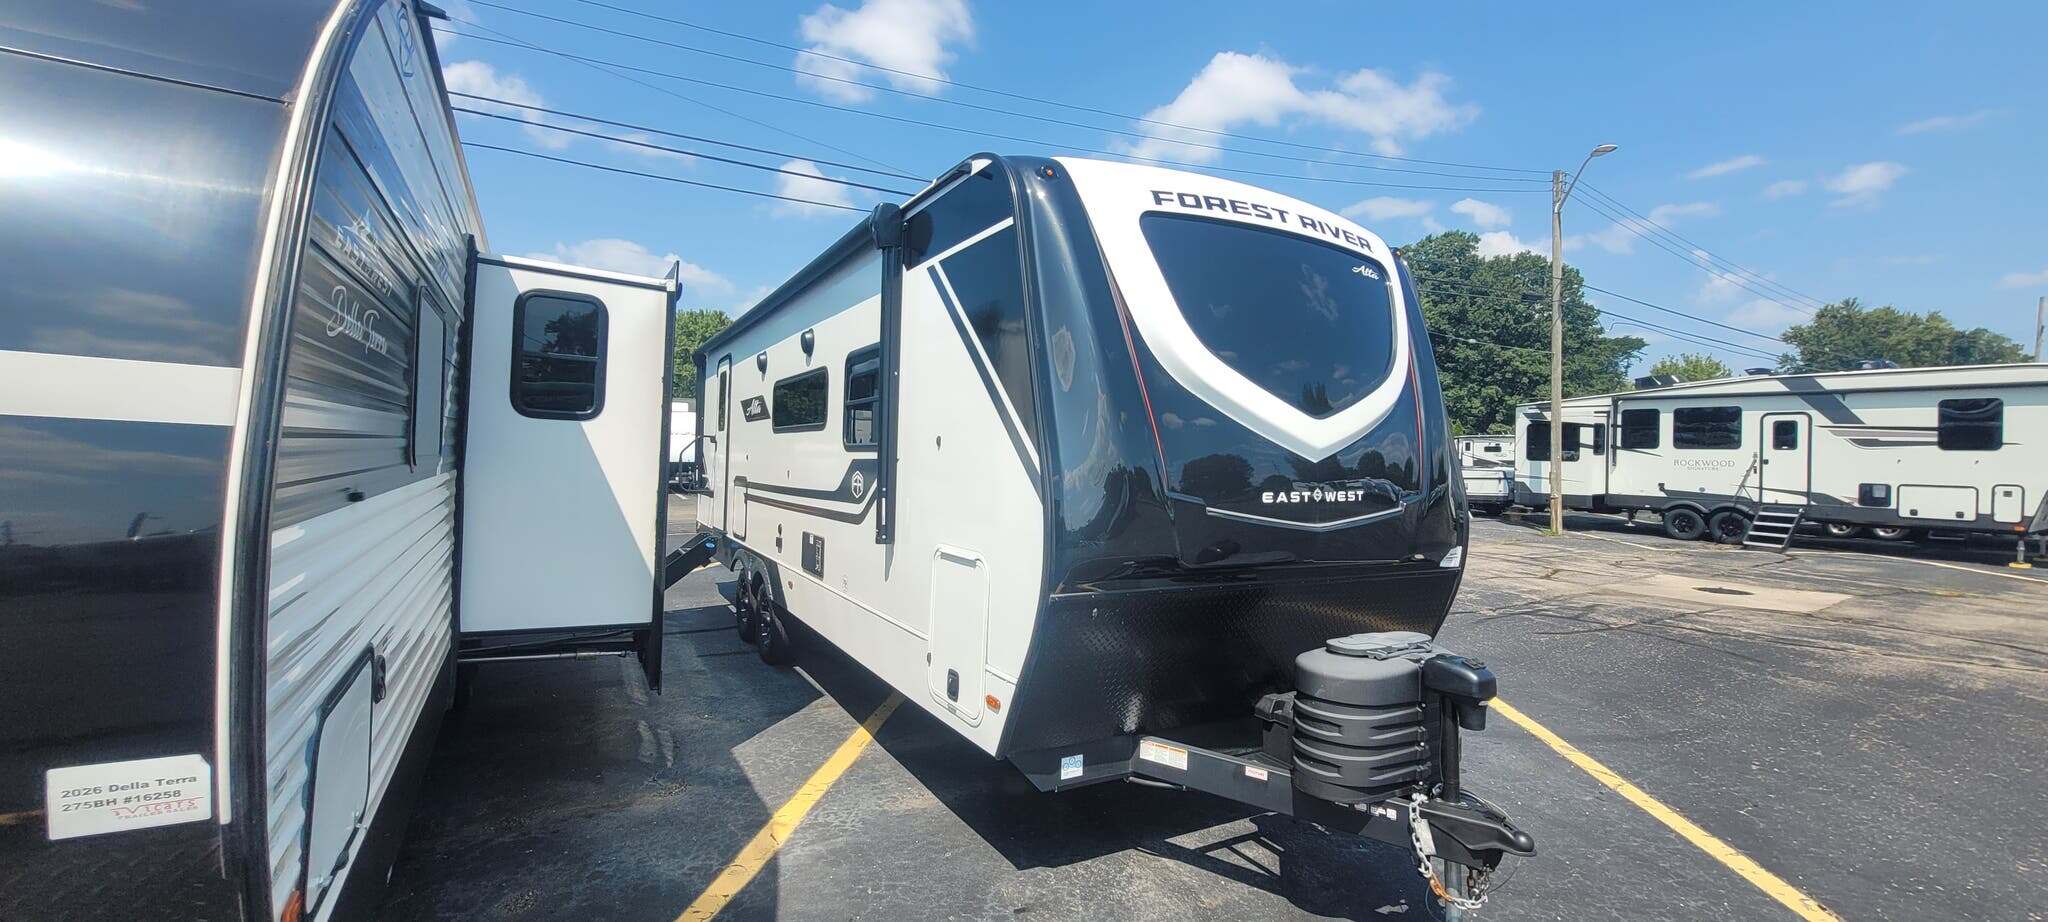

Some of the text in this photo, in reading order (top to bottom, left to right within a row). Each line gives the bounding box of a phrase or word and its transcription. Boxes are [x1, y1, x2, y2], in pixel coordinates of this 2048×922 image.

[1150, 190, 1374, 253] FOREST RIVER
[1352, 265, 1379, 280] Alta
[326, 285, 363, 340] Della
[1673, 459, 1735, 467] ROCKWOOD
[1262, 490, 1364, 503] EAST WEST
[60, 776, 197, 798] 2026 Della Terra
[62, 790, 181, 812] 275BH #16258
